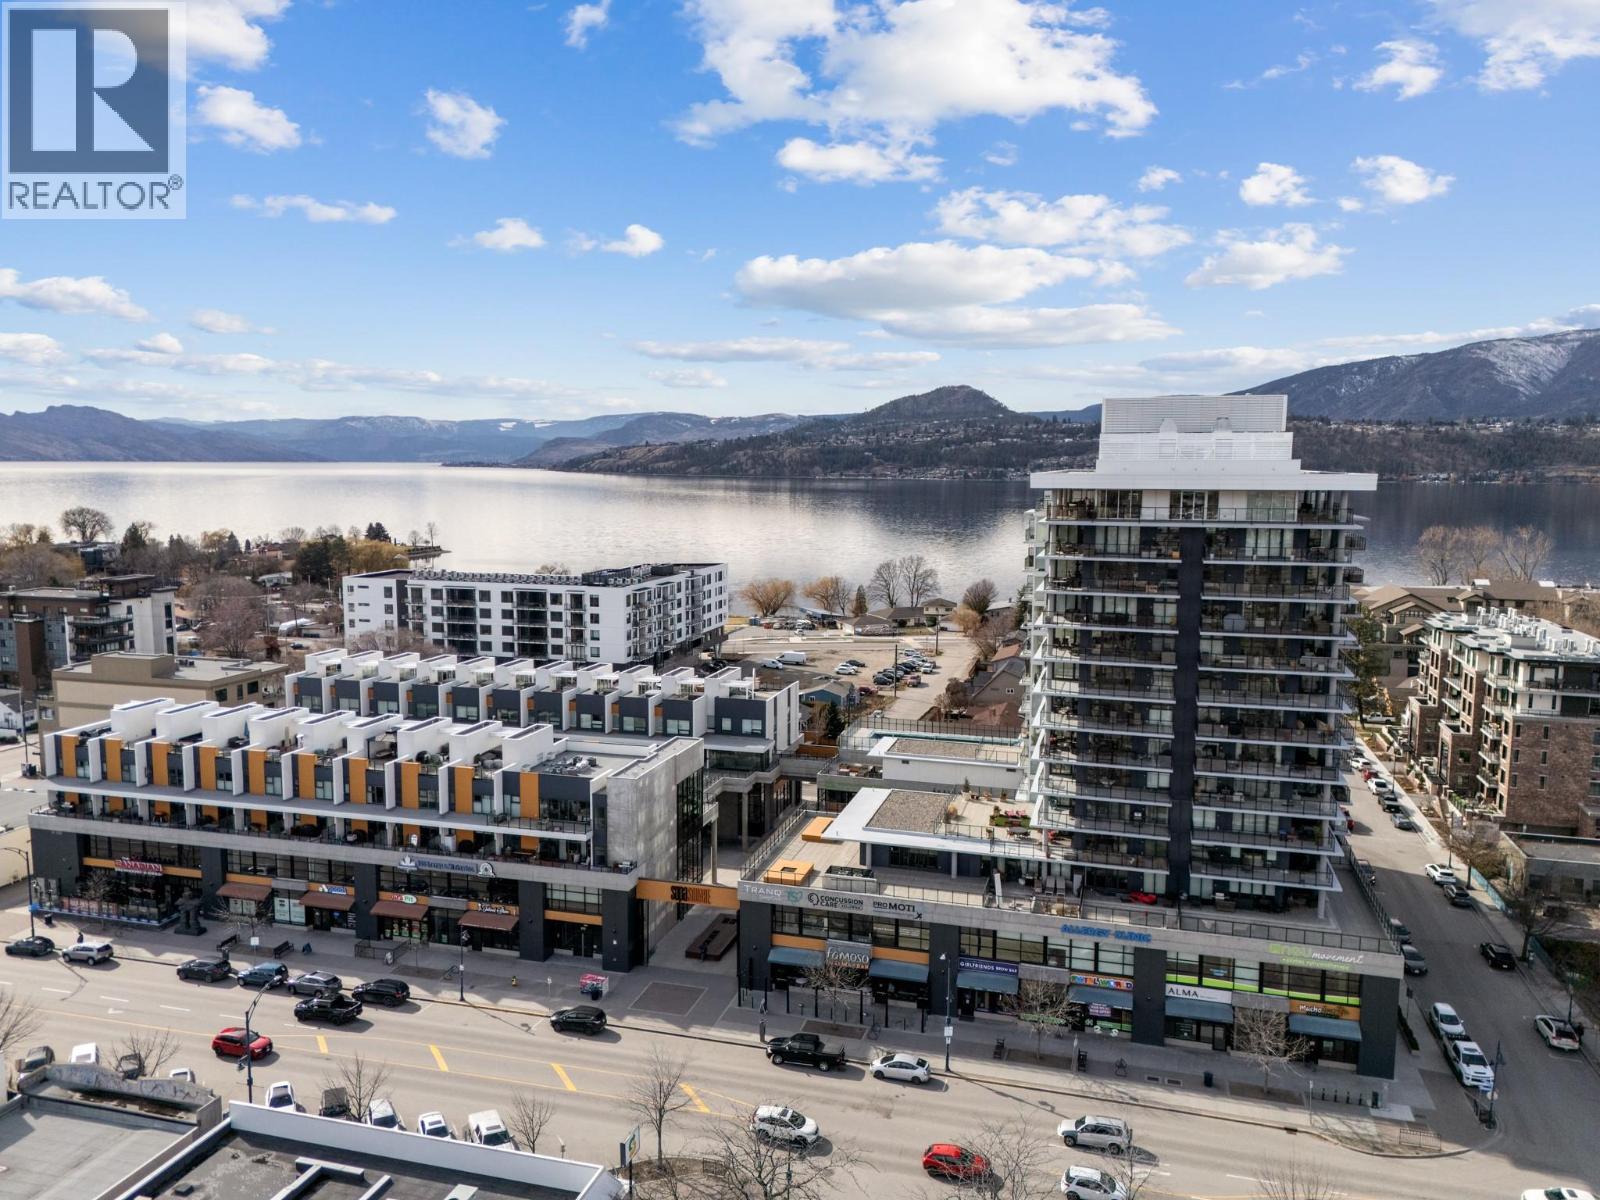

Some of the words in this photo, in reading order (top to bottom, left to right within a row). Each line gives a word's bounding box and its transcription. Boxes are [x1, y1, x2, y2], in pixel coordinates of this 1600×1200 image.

[820, 895, 864, 905] CONCUSSION
[1061, 924, 1109, 938] ALLERGY
[1115, 930, 1152, 943] CLINIC
[1311, 952, 1364, 964] movement
[960, 961, 995, 971] GIRLFRIENDS
[1168, 987, 1199, 998] ALMA
